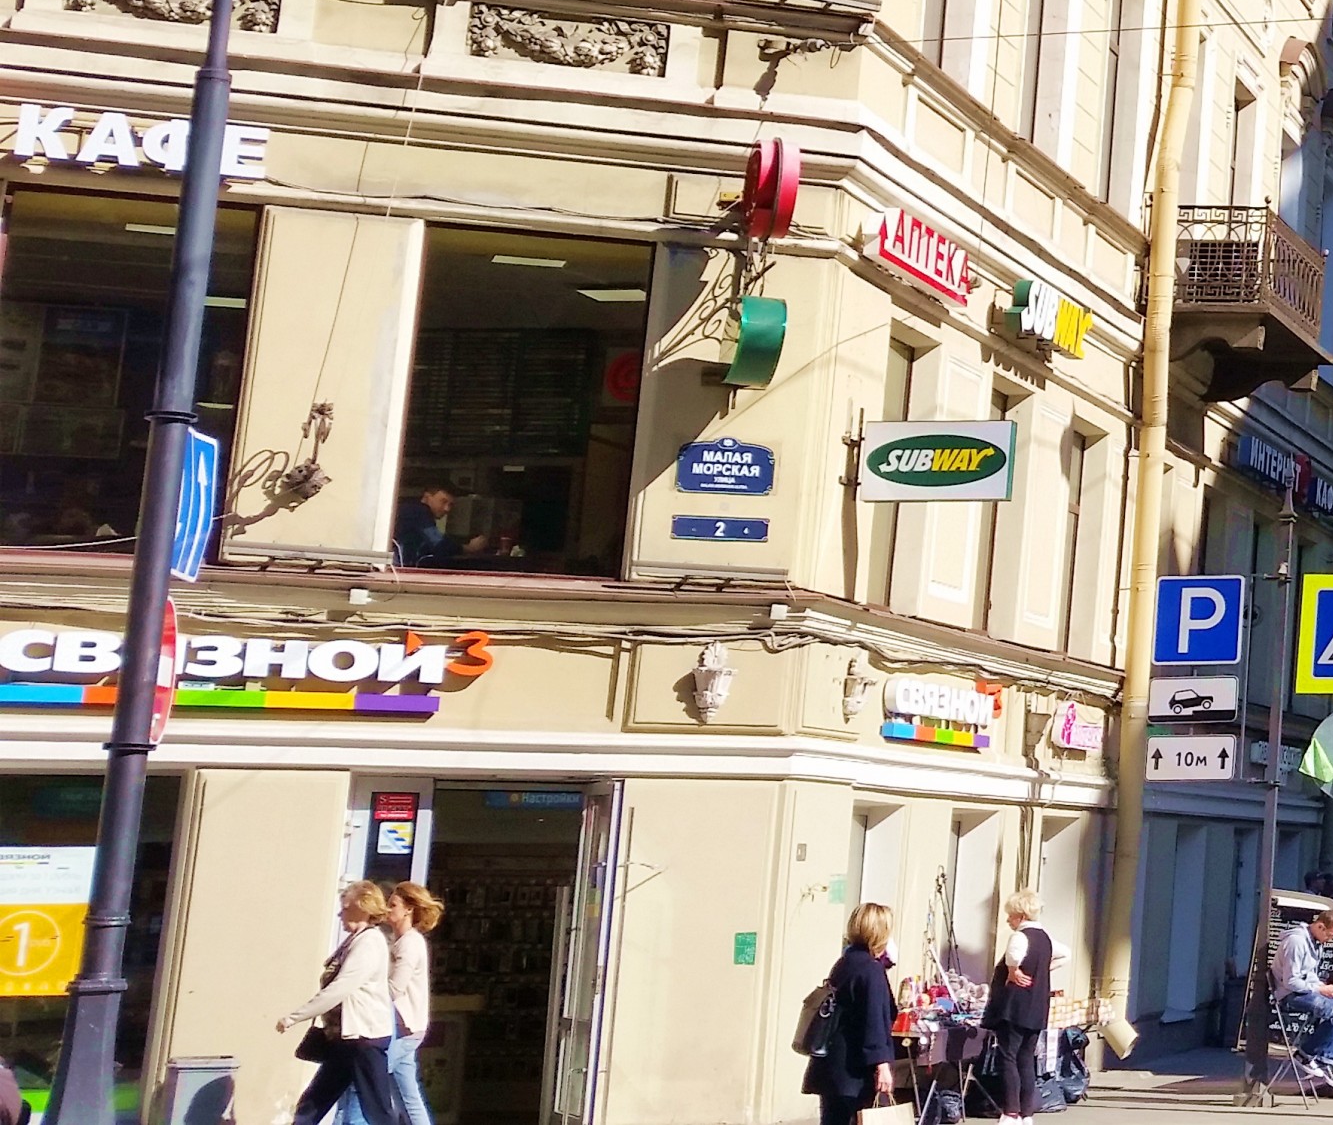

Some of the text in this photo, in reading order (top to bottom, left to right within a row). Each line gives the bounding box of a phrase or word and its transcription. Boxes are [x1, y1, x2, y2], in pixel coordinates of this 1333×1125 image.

[15, 103, 270, 179] КАФЕ
[892, 209, 971, 295] АПТЕКА
[1021, 280, 1094, 359] SUBWAY
[692, 463, 760, 477] МОРСКАЯ
[703, 450, 752, 463] МАЛАЯ
[879, 446, 995, 473] SUBWAY
[714, 521, 726, 536] 2
[1177, 587, 1225, 654] P
[1, 631, 445, 684] СВЗНОЙ
[896, 678, 994, 725] СВЯЗНОЙ
[1175, 751, 1207, 768] 10м
[13, 922, 30, 967] 1
